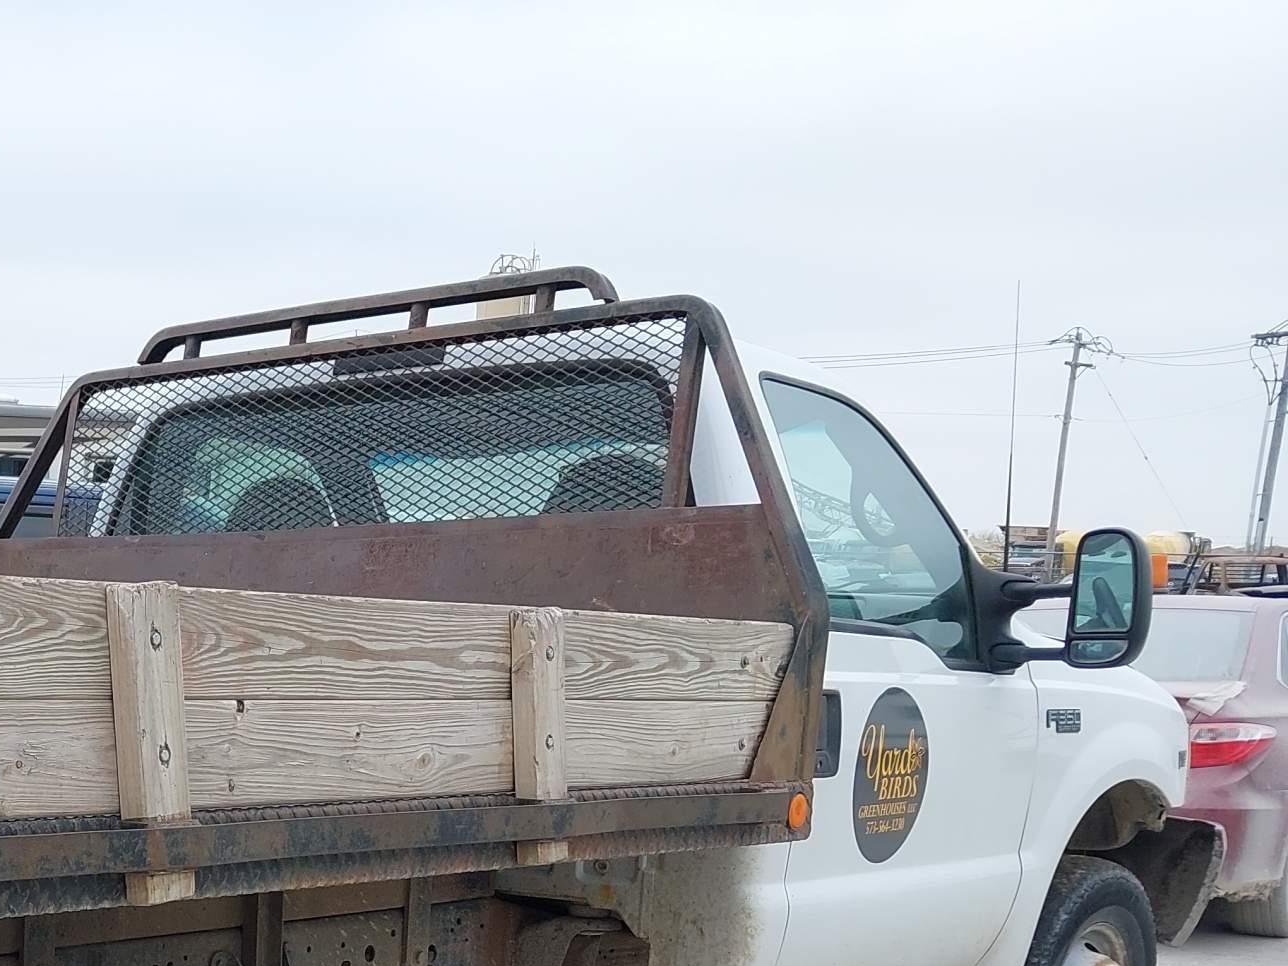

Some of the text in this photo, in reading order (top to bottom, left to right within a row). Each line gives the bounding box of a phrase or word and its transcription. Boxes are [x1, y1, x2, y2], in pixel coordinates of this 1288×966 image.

[861, 723, 916, 792] Yard
[878, 774, 920, 800] BIRDS
[857, 801, 907, 819] GREENHOUSES
